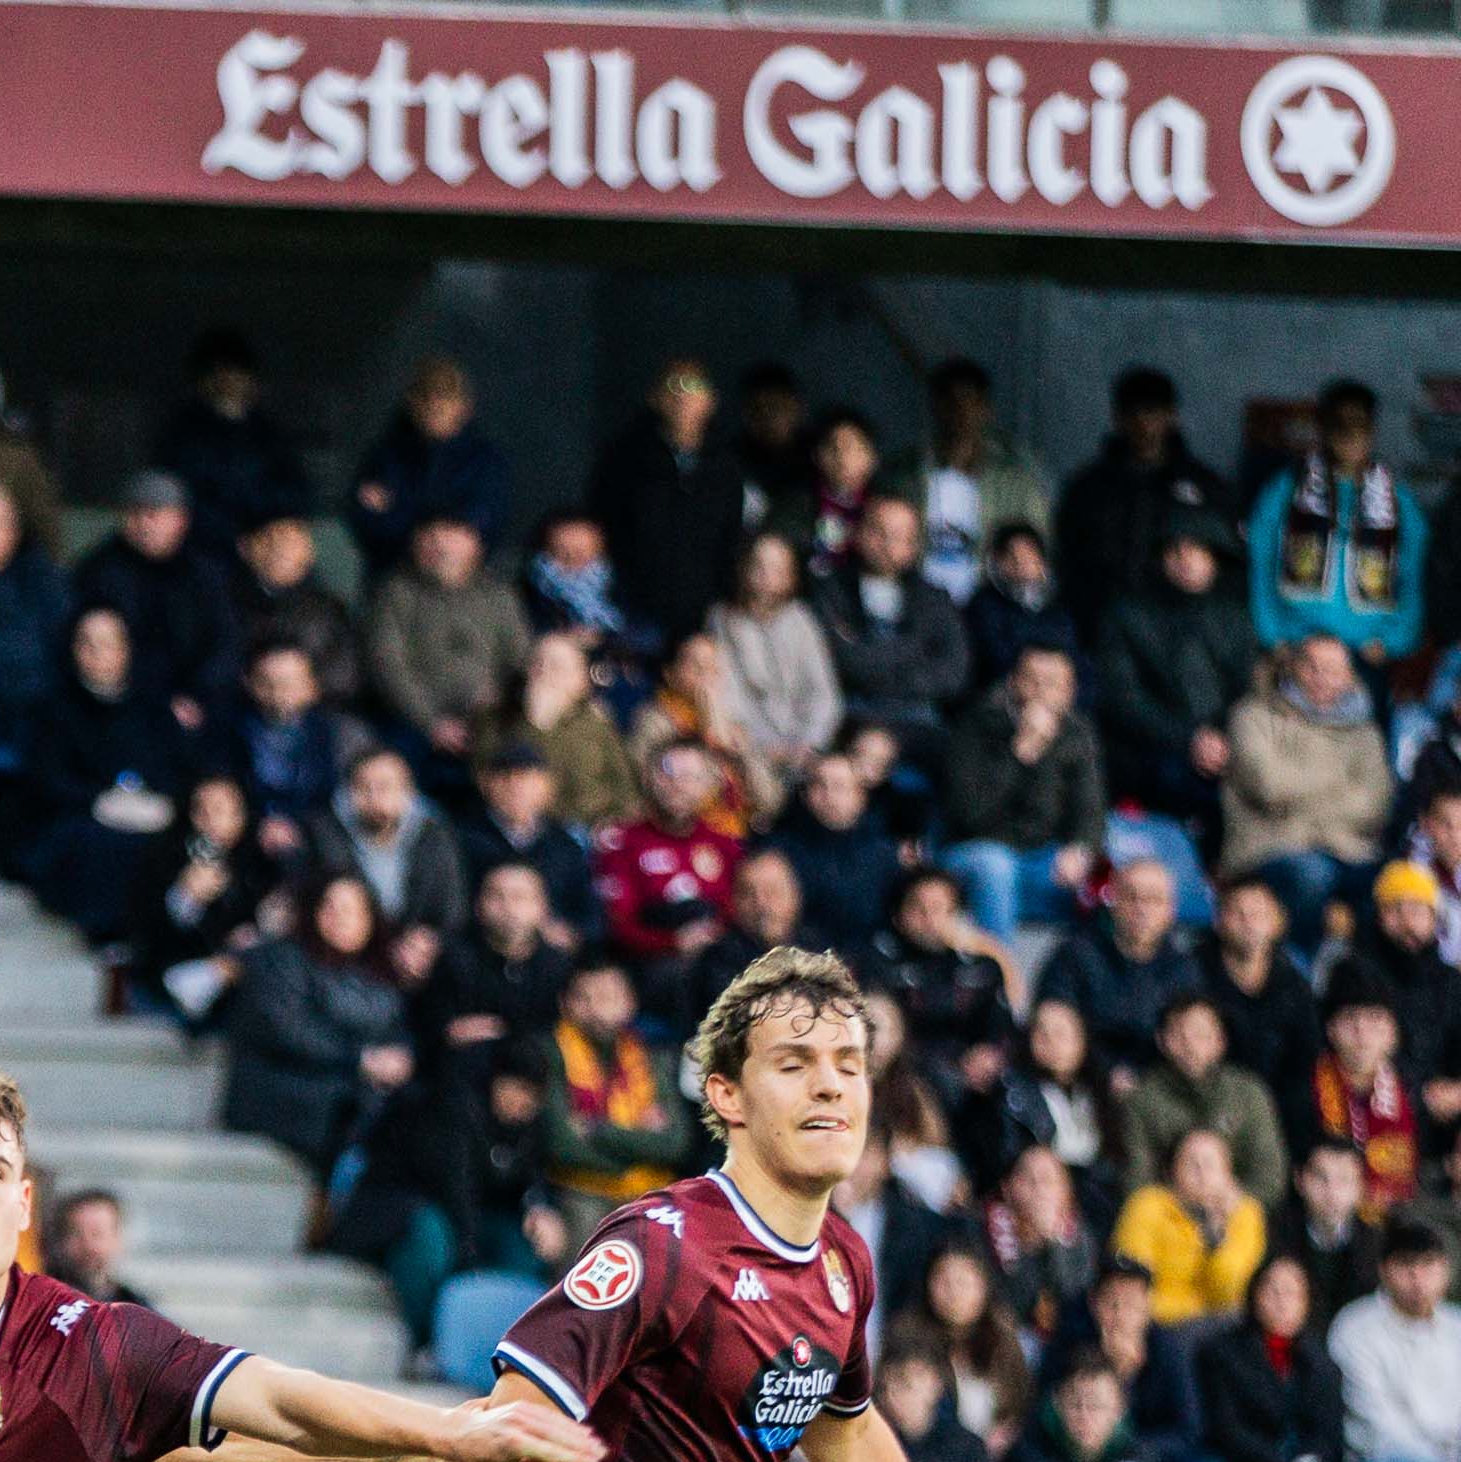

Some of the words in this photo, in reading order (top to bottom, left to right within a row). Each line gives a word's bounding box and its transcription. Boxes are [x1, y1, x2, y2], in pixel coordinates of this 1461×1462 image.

[201, 28, 725, 190] Estrella
[742, 44, 1215, 210] Galicia
[757, 1367, 838, 1398] Estrella
